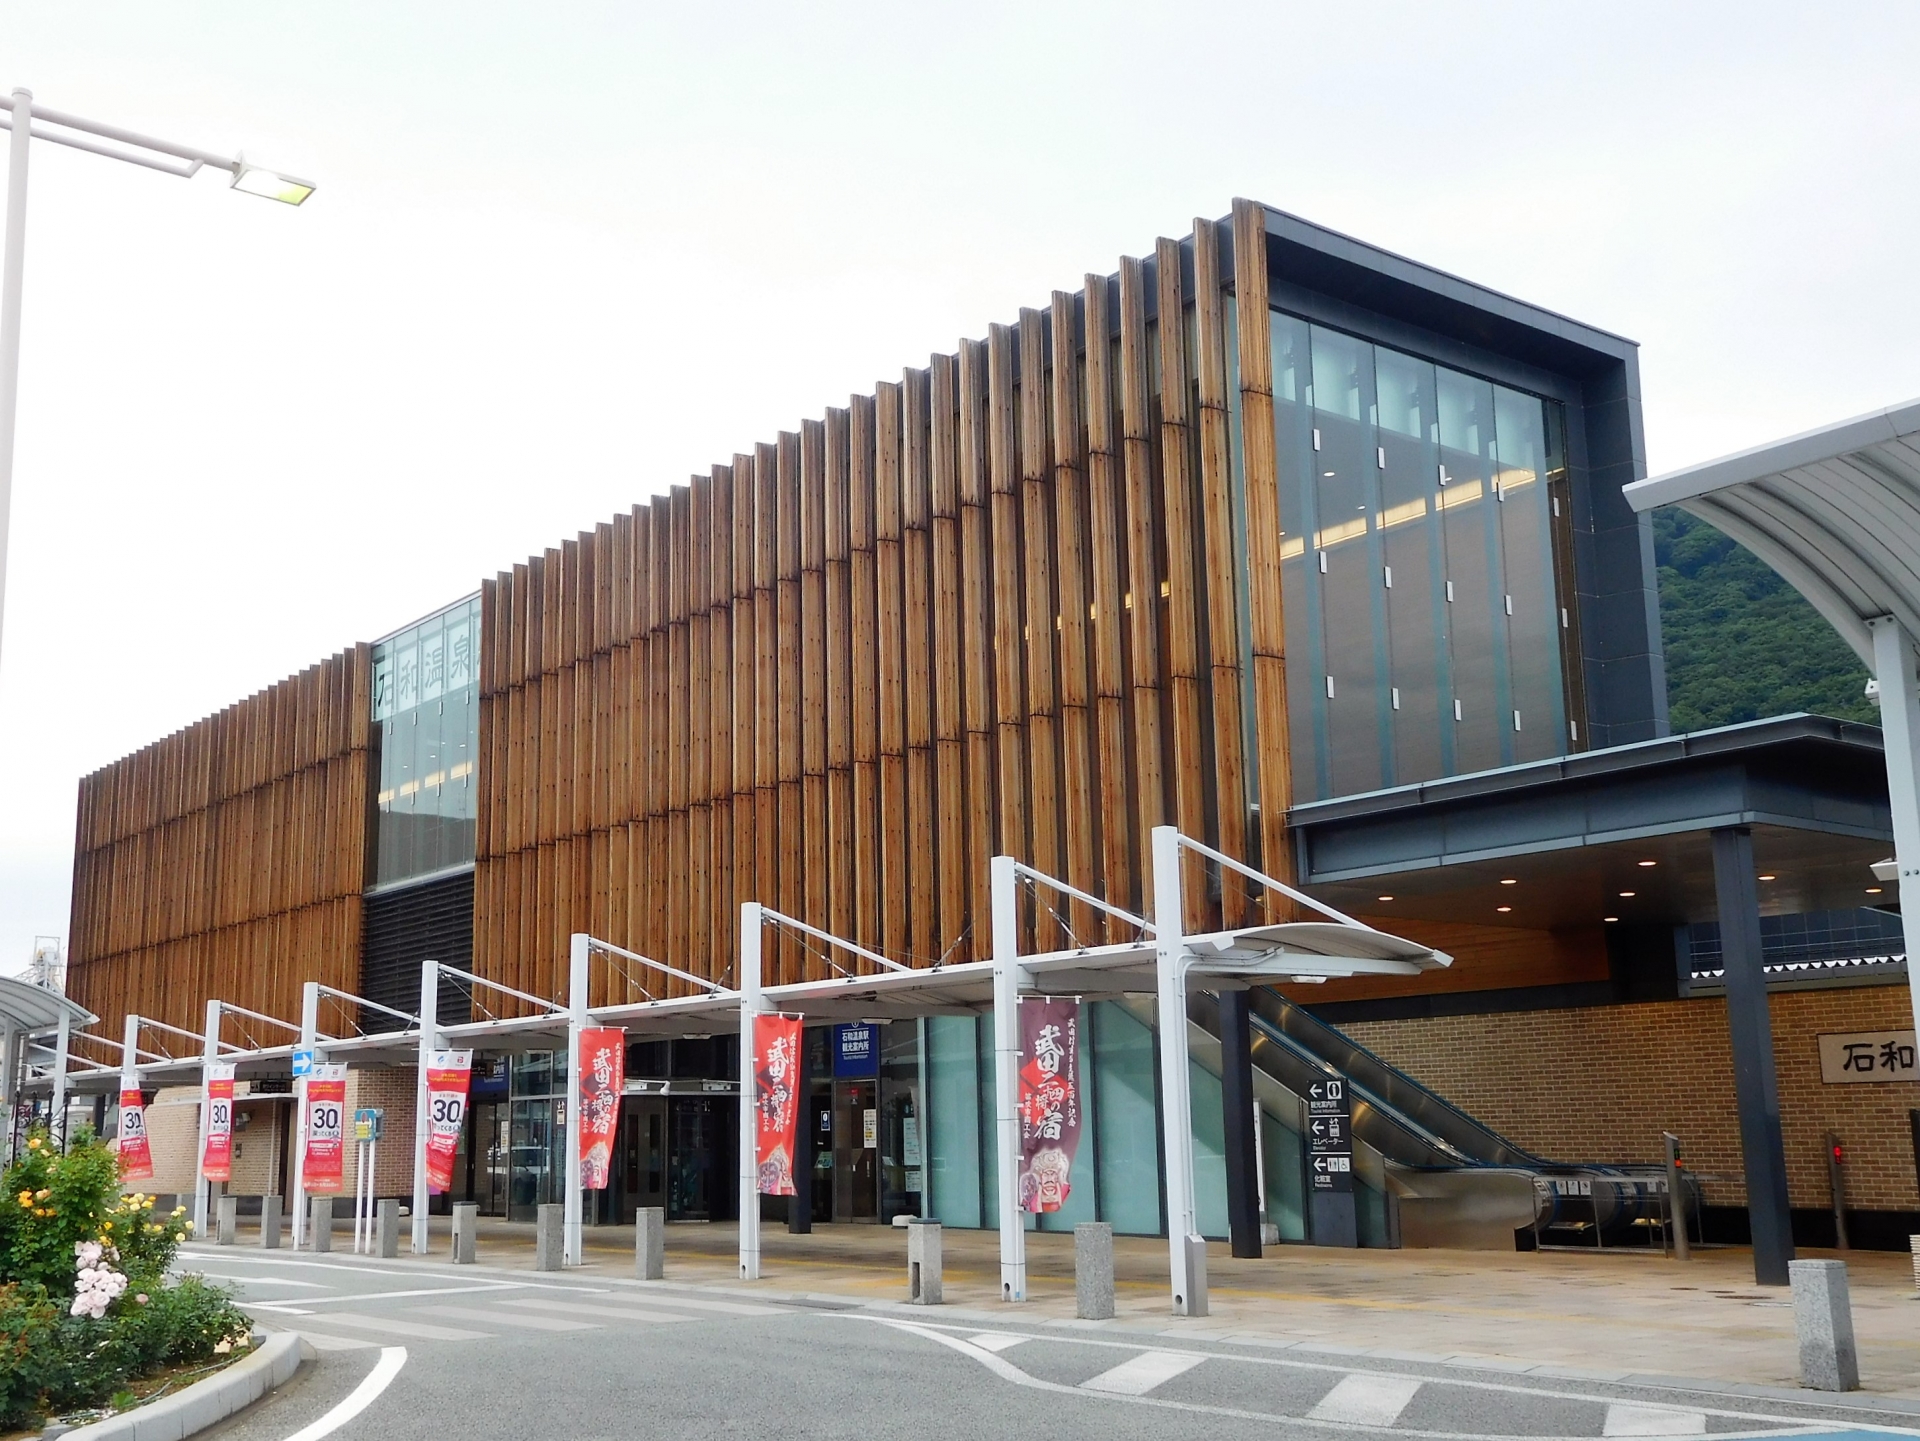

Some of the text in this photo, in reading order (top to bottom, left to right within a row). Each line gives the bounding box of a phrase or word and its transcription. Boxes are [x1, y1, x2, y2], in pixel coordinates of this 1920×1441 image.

[378, 627, 481, 708] 石和温泉
[842, 1031, 869, 1042] 石和温泉駅
[842, 1041, 869, 1052] 観光案内所
[1843, 1041, 1914, 1072] 石和
[1310, 1100, 1337, 1108] 観光案内所
[1312, 1137, 1344, 1145] エレベーター
